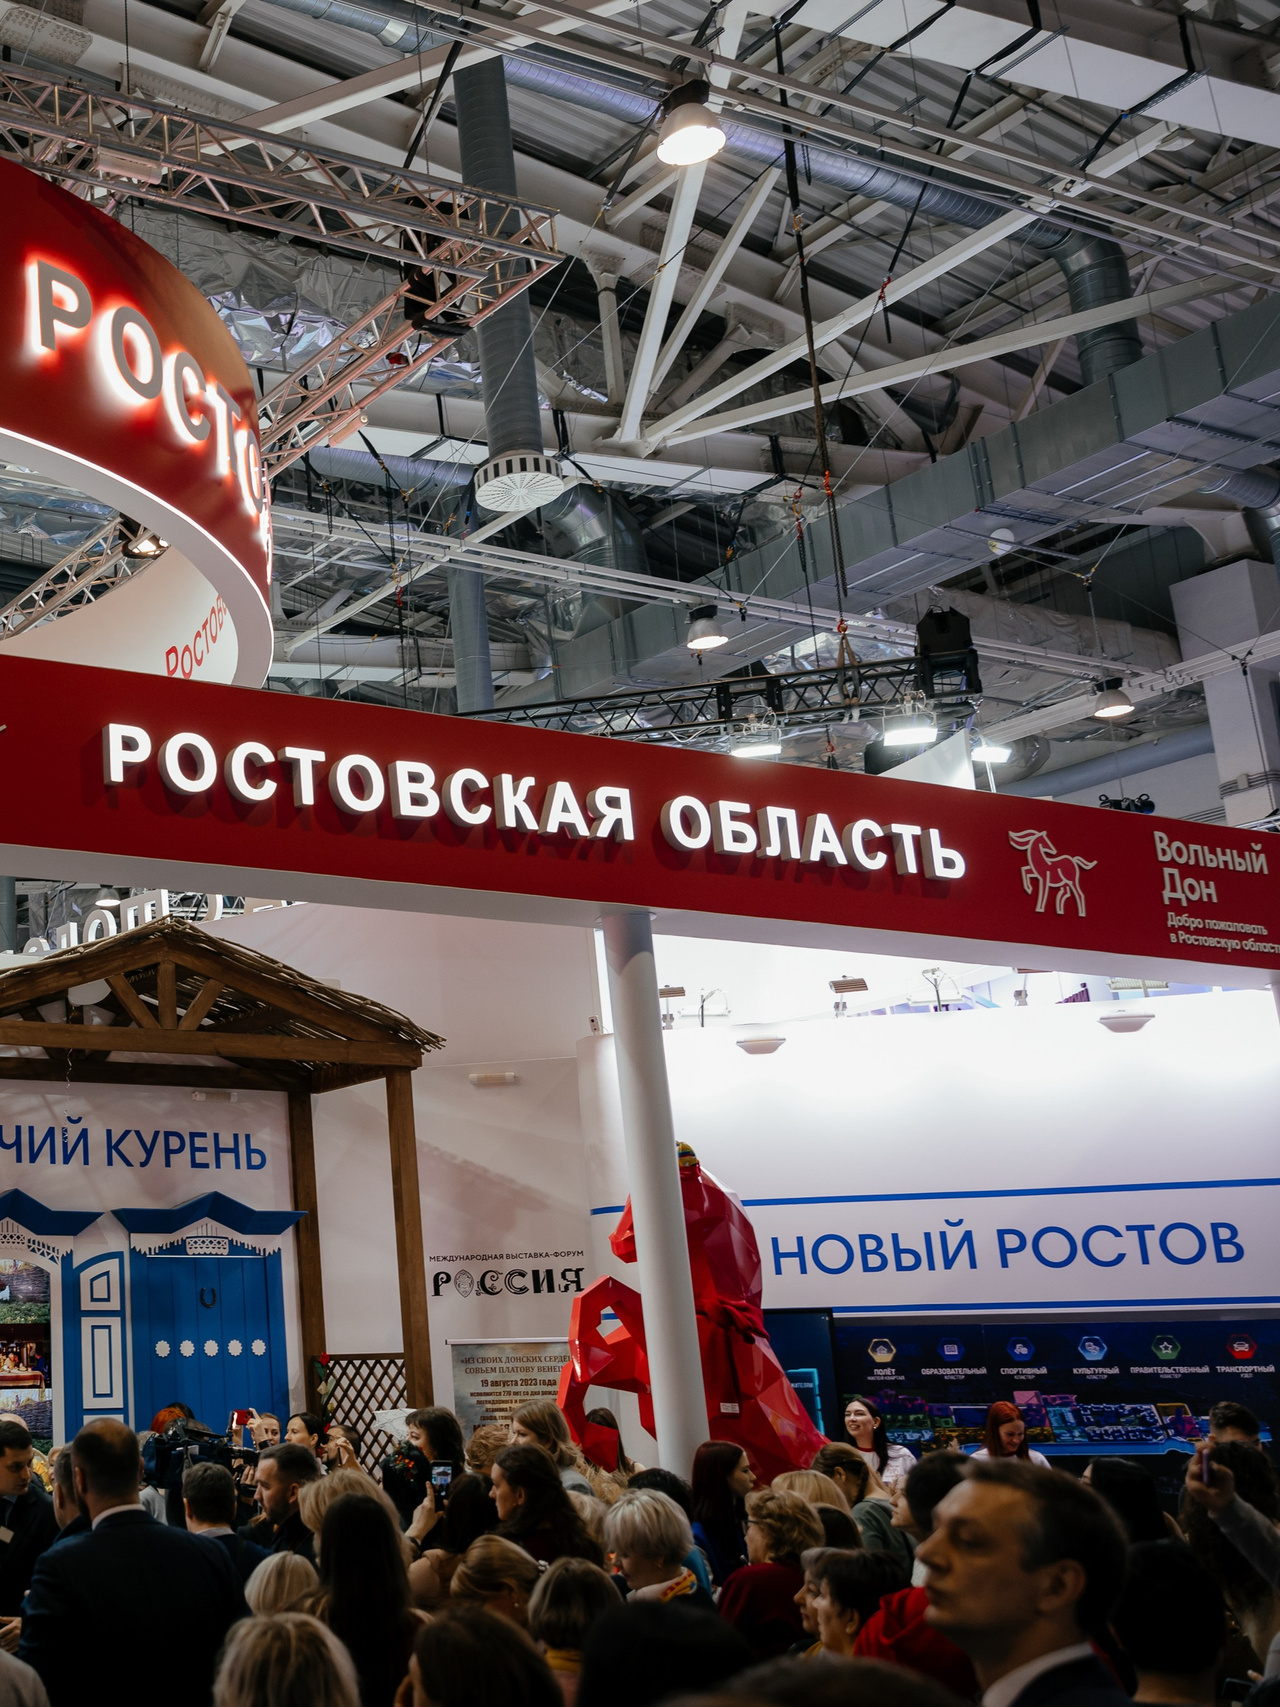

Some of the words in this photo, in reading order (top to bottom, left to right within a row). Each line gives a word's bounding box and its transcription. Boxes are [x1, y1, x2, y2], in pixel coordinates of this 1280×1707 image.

[36, 259, 272, 585] РОСТО
[105, 722, 634, 843] РОСТОВСКАЯ
[664, 794, 968, 882] ОБЛАСТЬ
[1153, 830, 1269, 875] Вольный
[1162, 867, 1218, 906] Дон
[1167, 912, 1203, 931] Добро
[1205, 918, 1268, 936] пожаловать
[1170, 932, 1177, 943] в
[1178, 931, 1241, 952] Ростовскую
[1242, 935, 1280, 955] област
[106, 1128, 268, 1171] КУРЕНЬ
[771, 1218, 978, 1276] НОВЫЙ
[996, 1221, 1245, 1269] РОСТОВ
[429, 1253, 504, 1263] МЕЖДУНАРОДНАЯ
[506, 1250, 584, 1260] ВЫСТАВКА-ФОРУМ
[431, 1267, 585, 1299] РОССИЯ
[476, 1356, 503, 1364] СВОИХ
[504, 1355, 543, 1364] ДОНСКИХ
[465, 1367, 497, 1375] СОВЬЕМ
[498, 1365, 535, 1374] ПЛАТОВУ
[874, 1367, 896, 1376] ПОЛЁТ
[921, 1366, 987, 1375] ОБРАЗОВАТЕЛЬНЫЙ
[1000, 1366, 1048, 1375] СПОРТИВНЫЙ
[1073, 1365, 1120, 1375] КУЛЬТУРНЫЙ
[1130, 1365, 1210, 1374] ПРАВИТЕЛЬСТВЕННЫЙ
[1216, 1364, 1275, 1373] ТРАНСПОРТНЫЙ
[481, 1379, 489, 1388] 19
[490, 1379, 519, 1388] августа
[520, 1378, 538, 1387] 2023
[539, 1378, 557, 1387] года
